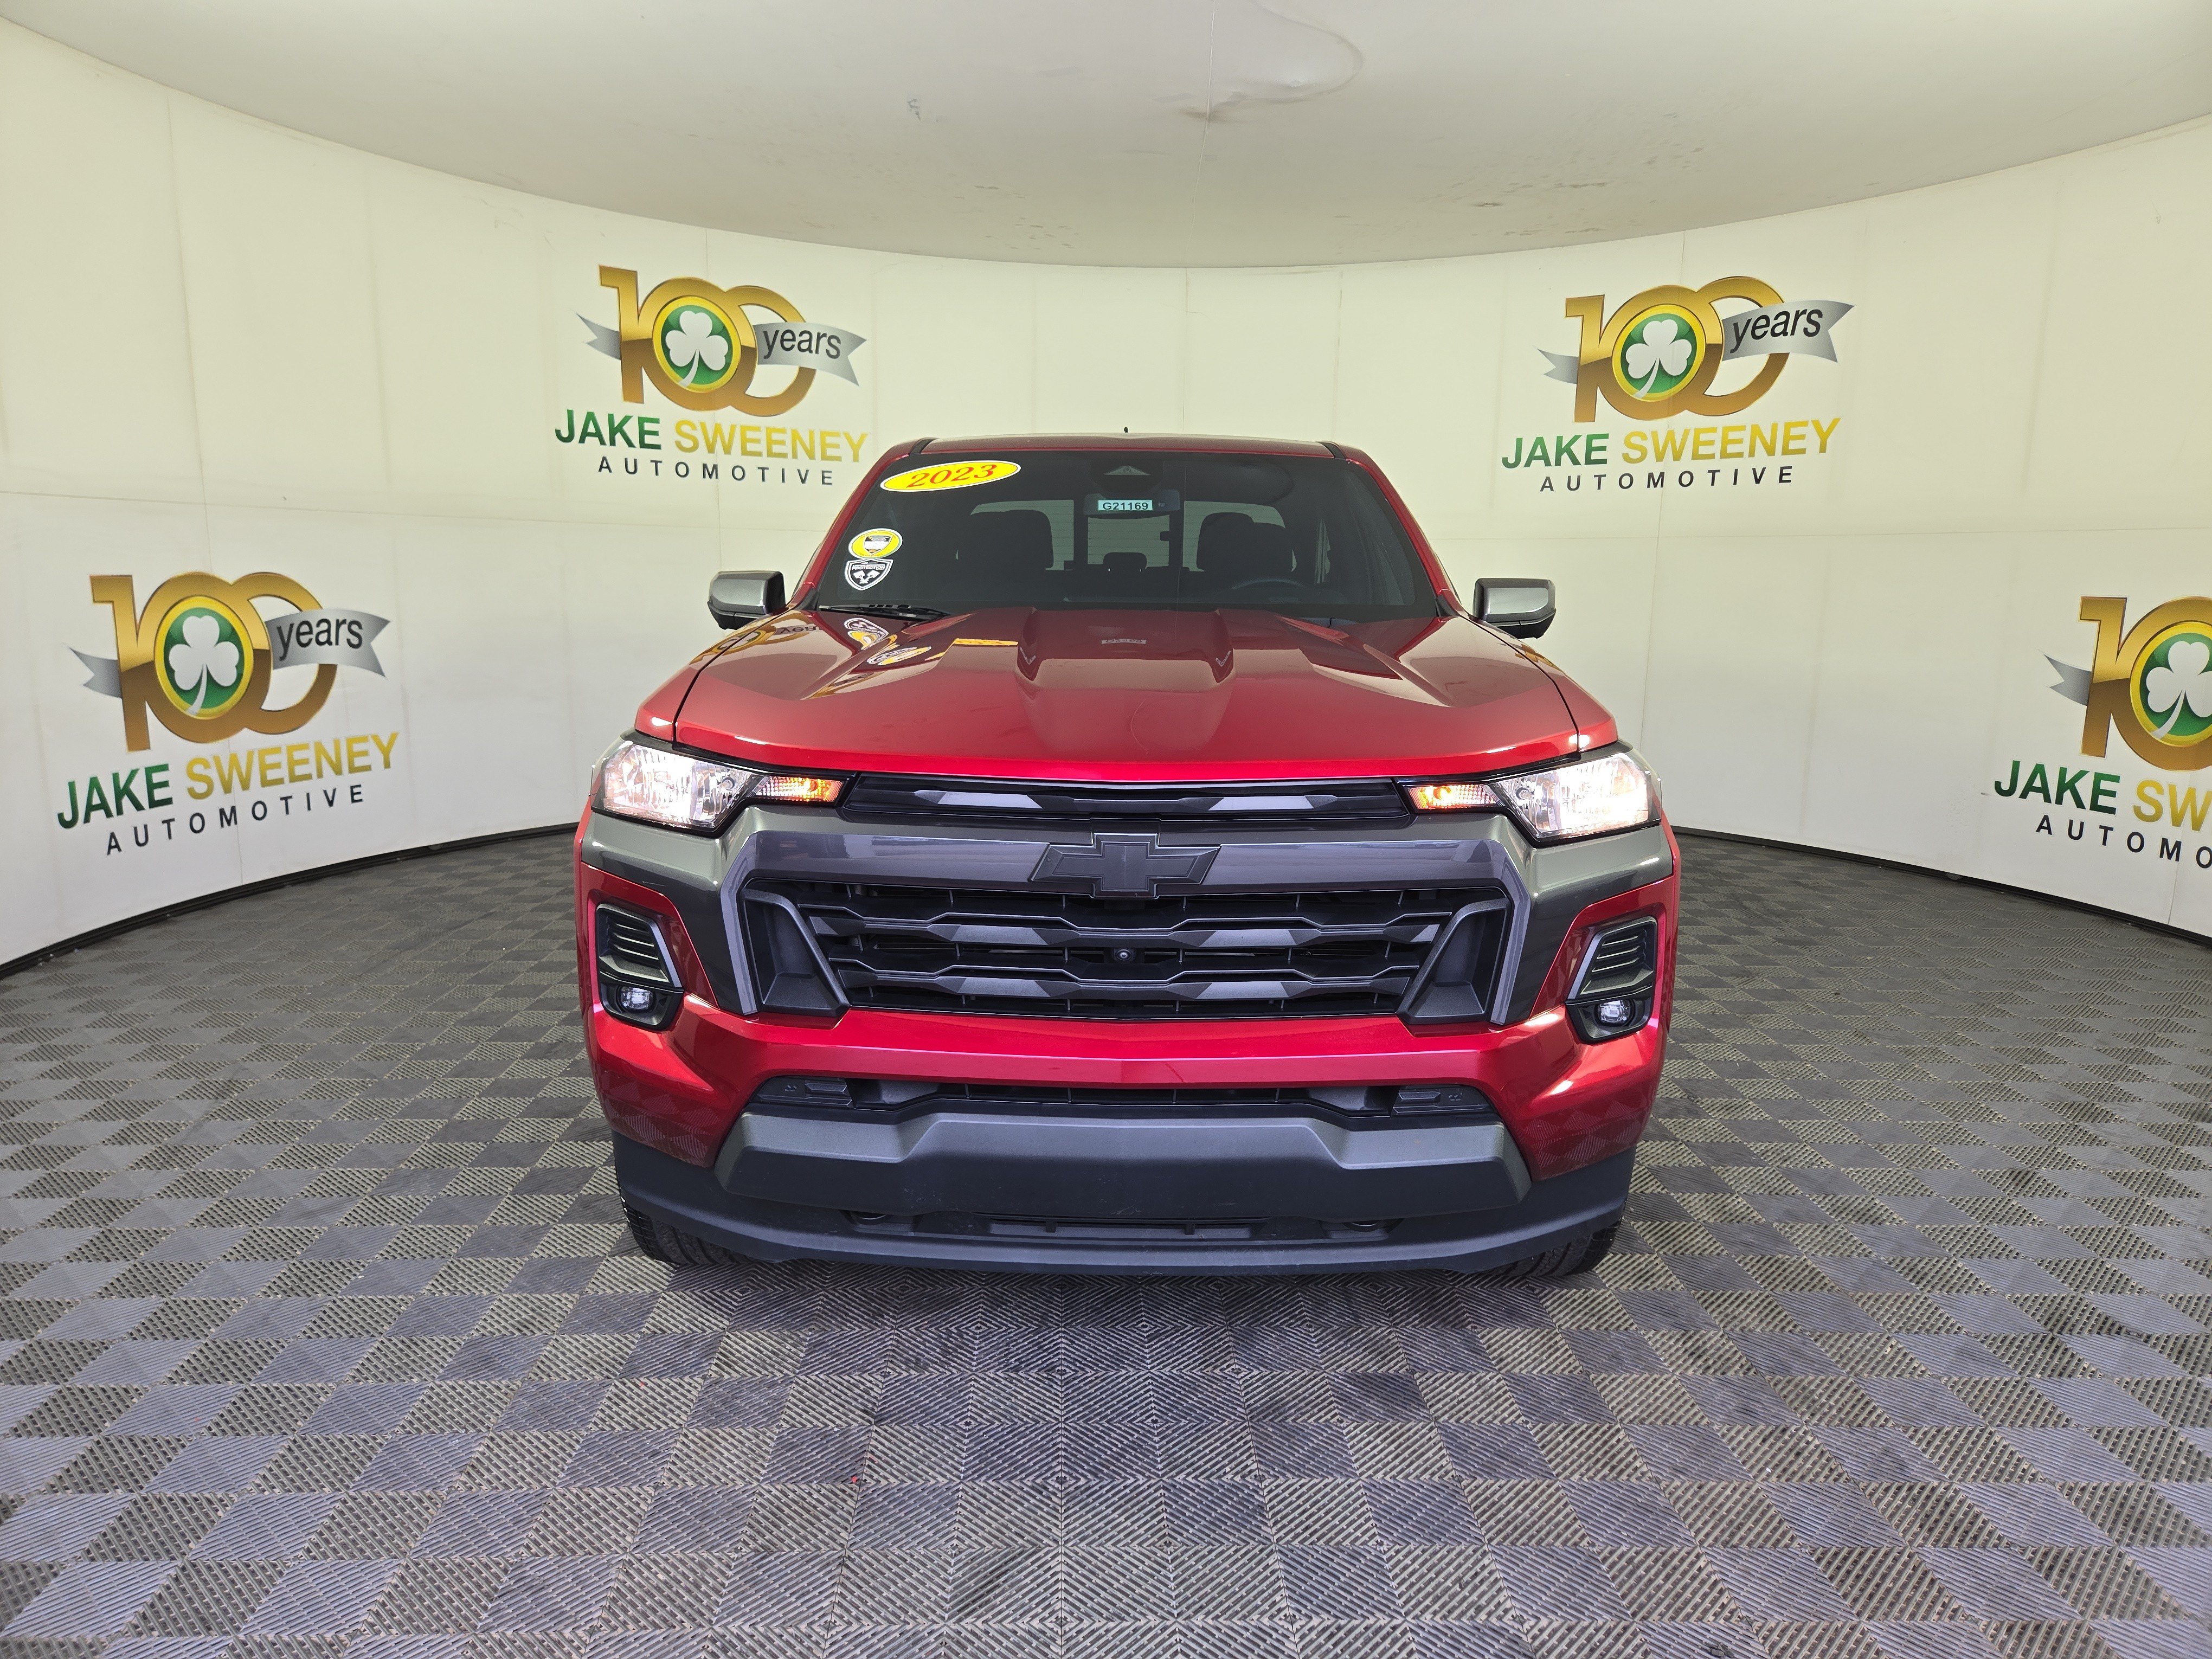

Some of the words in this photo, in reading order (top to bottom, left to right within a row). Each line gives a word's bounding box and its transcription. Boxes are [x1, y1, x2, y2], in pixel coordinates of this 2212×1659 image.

[762, 329, 841, 360] years
[1729, 308, 1823, 353] years
[555, 409, 662, 450] JAKE
[674, 419, 869, 463] SWEENEY
[1502, 433, 1609, 469] JAKE
[1622, 417, 1842, 465] SWEENEY
[598, 456, 833, 485] AUTOMOTIVE
[906, 464, 998, 488] 2023
[1540, 466, 1793, 492] AUTOMOTIVE
[1102, 502, 1148, 510] G21169
[276, 618, 363, 661] years
[57, 763, 173, 829] JAKE
[186, 732, 400, 800] SWEENEY
[1994, 760, 2120, 815] JAKE
[106, 785, 363, 856] AUTOMOTIVE
